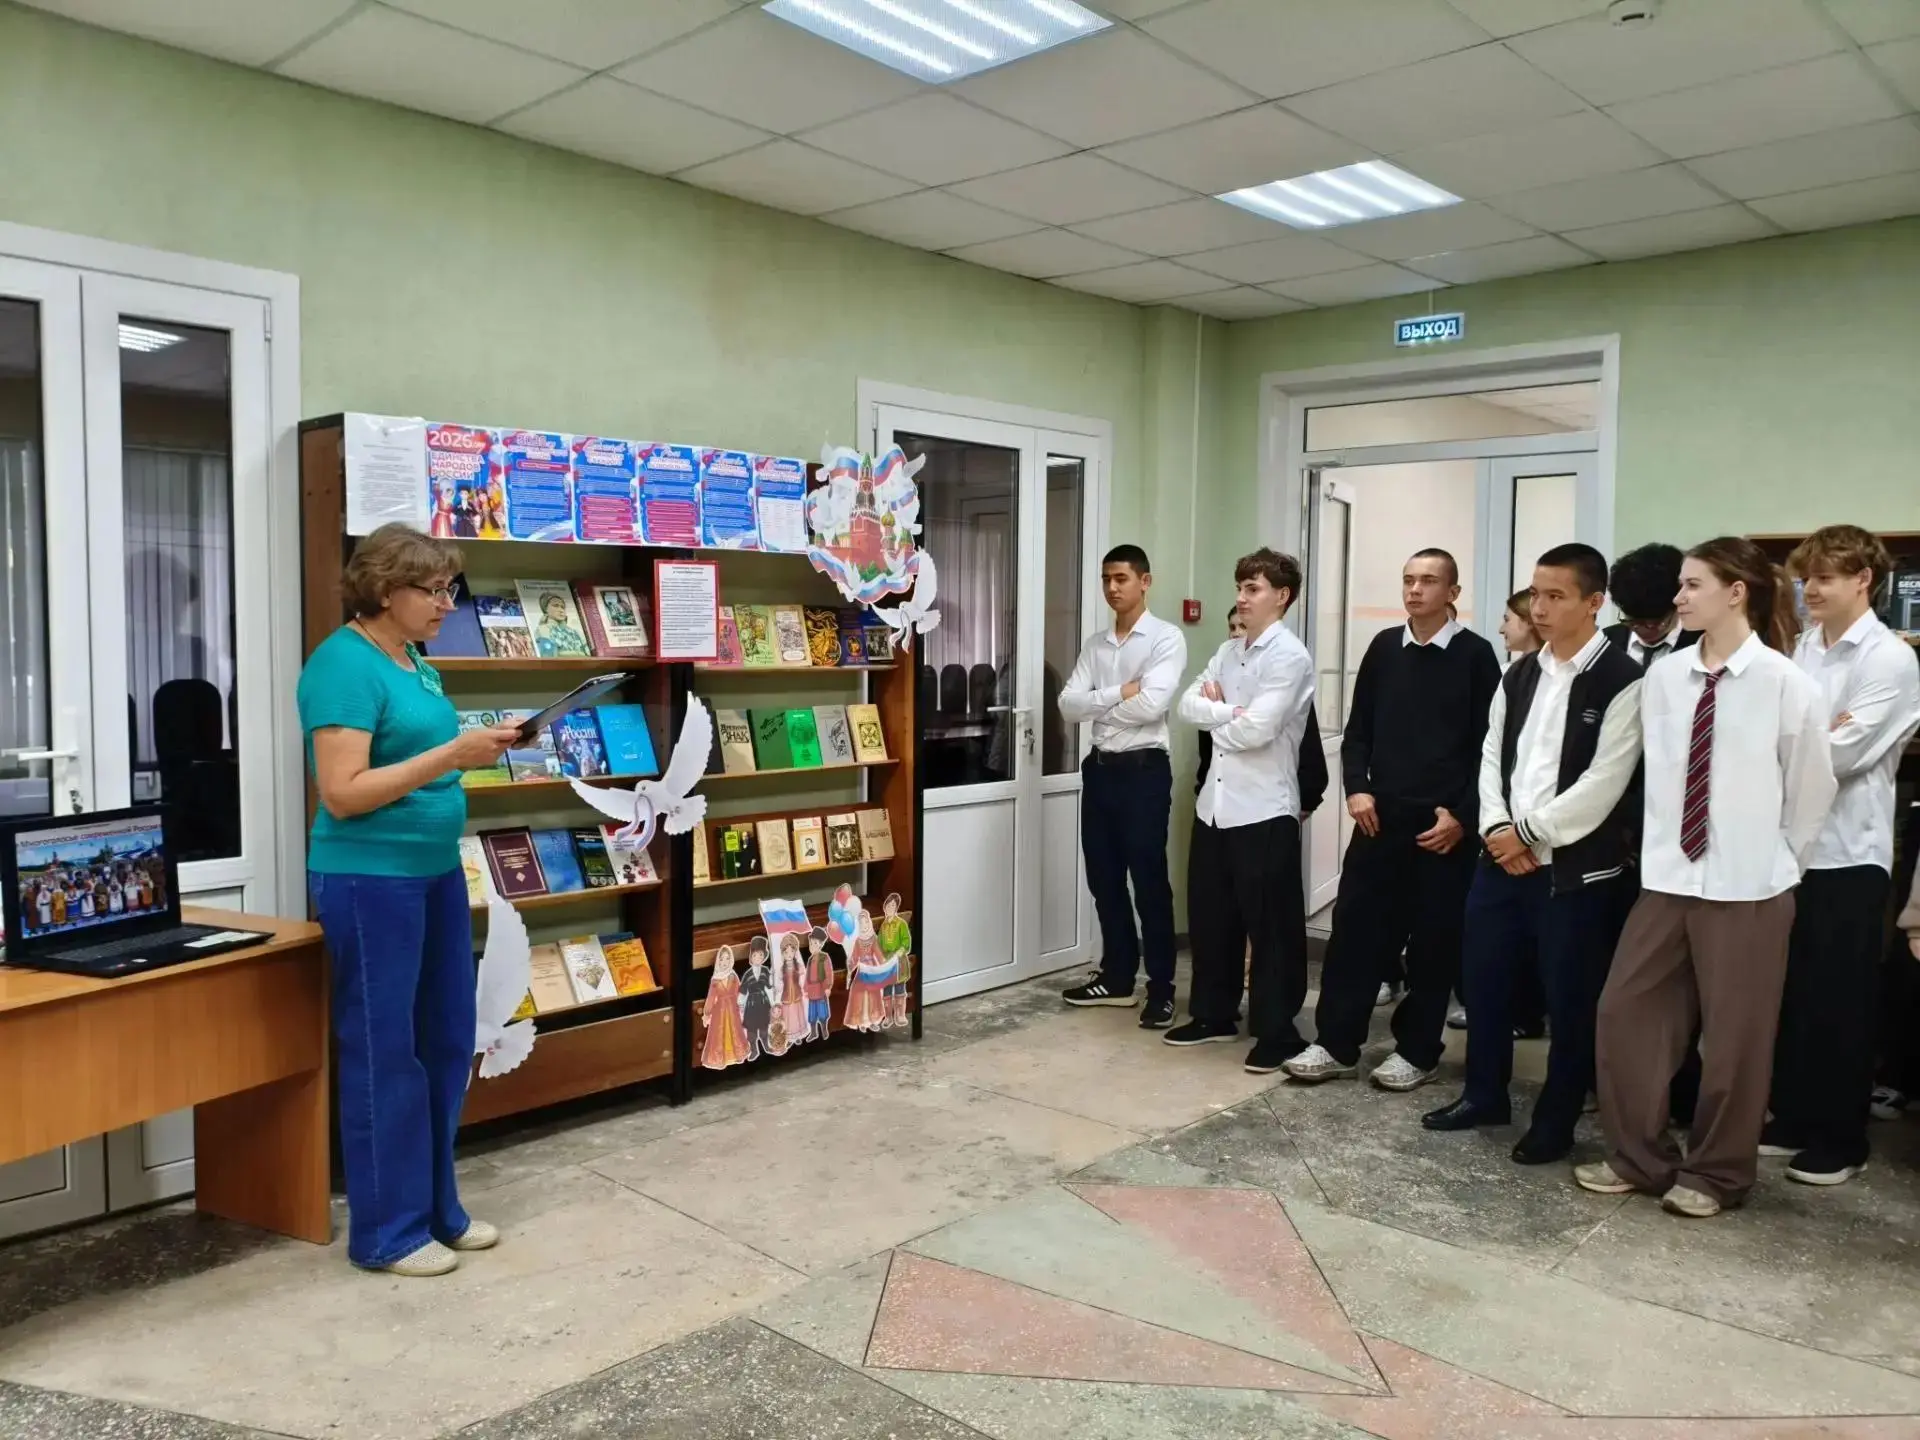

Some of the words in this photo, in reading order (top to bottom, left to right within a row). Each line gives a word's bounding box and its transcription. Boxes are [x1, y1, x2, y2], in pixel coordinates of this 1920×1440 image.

[1401, 319, 1457, 339] ВЫХОД
[429, 430, 472, 449] 2026
[431, 452, 485, 463] ЕДИНСТВА
[431, 460, 480, 472] НАРОДОВ
[431, 469, 474, 479] РОССИИ
